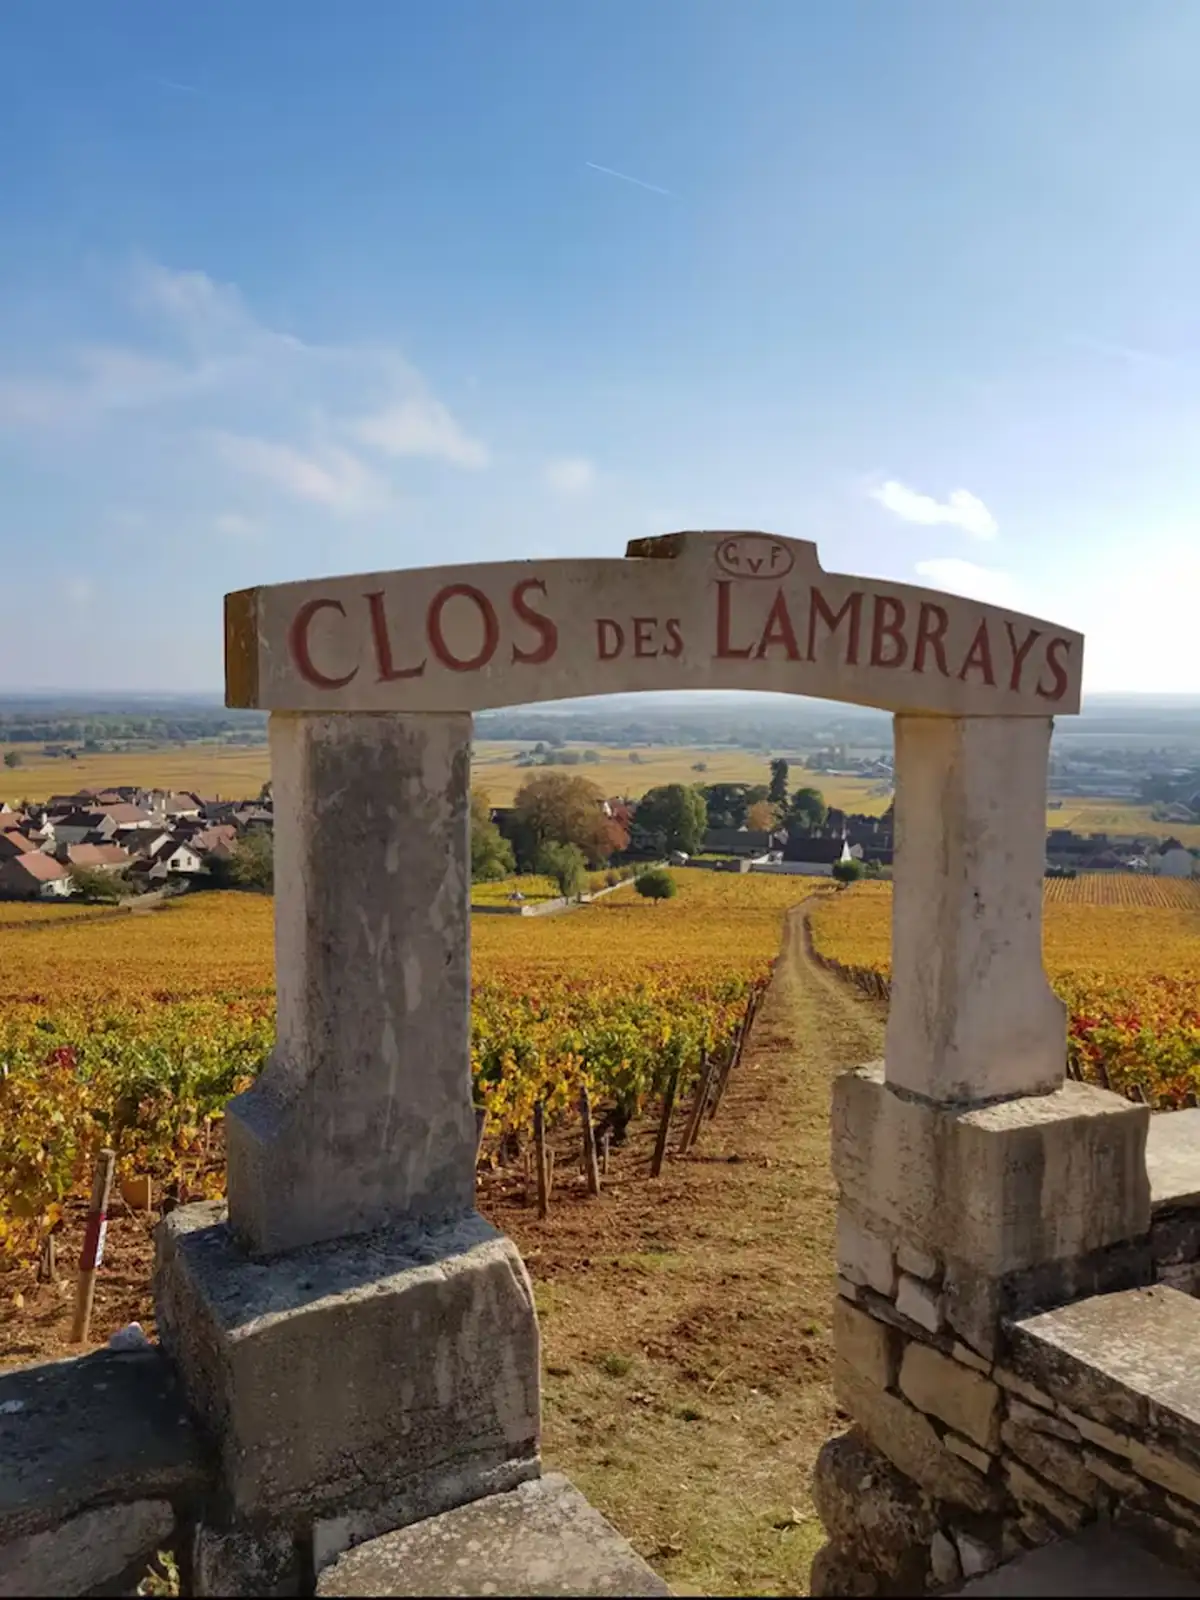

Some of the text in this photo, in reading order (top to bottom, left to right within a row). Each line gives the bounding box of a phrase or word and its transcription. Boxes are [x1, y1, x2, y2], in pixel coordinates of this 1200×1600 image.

[289, 578, 1072, 701] CLOS DES LAMBRAYS
